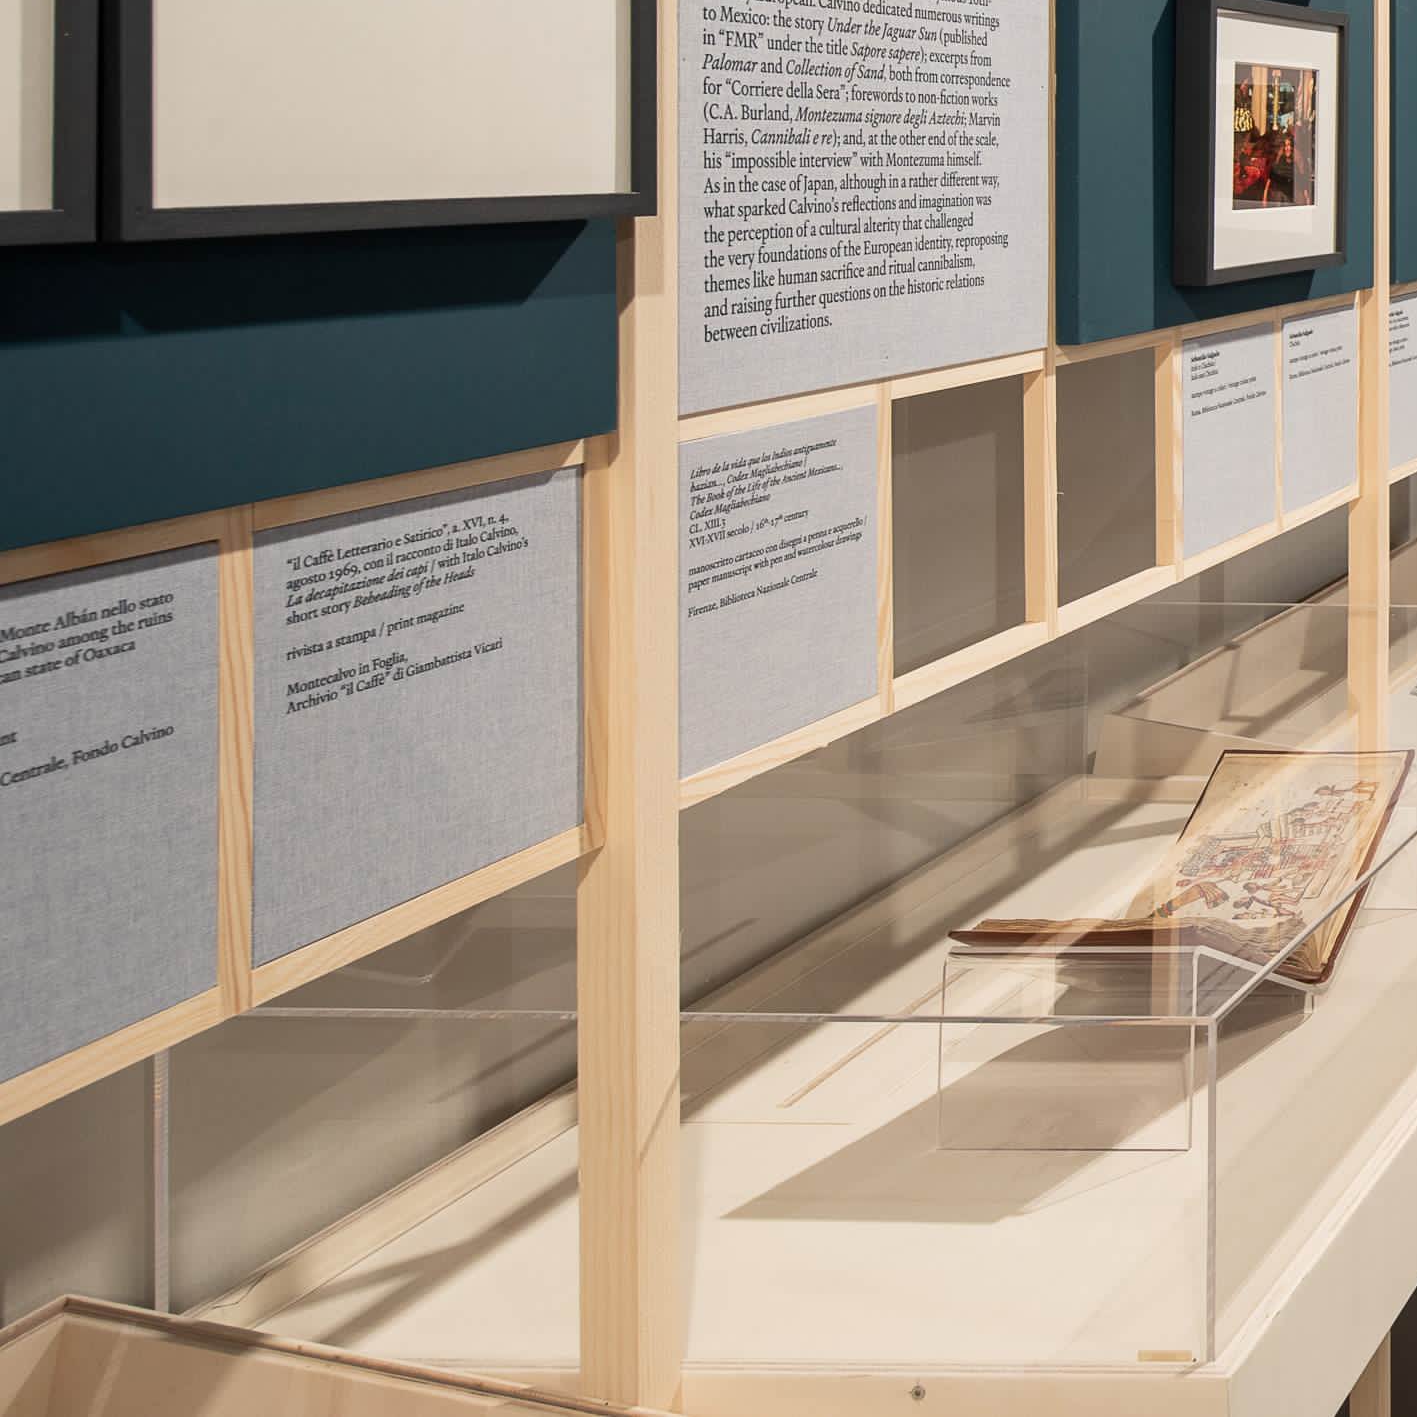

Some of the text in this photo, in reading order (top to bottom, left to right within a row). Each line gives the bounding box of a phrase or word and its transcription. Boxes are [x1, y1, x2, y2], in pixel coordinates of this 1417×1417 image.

[704, 253, 976, 293] themes like human sacrifice and ritual cannibalism,
[704, 273, 985, 318] and raising further questions on the historic relations
[704, 313, 832, 343] between civilizations.
[286, 526, 519, 592] agosto 1969, con il racconto di Italo Calvino,
[303, 549, 335, 568] Caffè
[336, 538, 394, 560] Letterario
[394, 538, 402, 547] e
[462, 515, 486, 531] XVI,
[284, 590, 303, 608] La
[305, 575, 386, 603] decapitazione
[386, 567, 405, 582] dei
[406, 561, 429, 578] capi
[437, 553, 460, 568] with
[462, 547, 485, 564] Italo
[286, 565, 476, 626] short story Beheading of the Heads
[0, 593, 174, 643] Monte Albán nello stato
[57, 628, 109, 649] among
[111, 620, 135, 636] the
[137, 612, 174, 630] ruins
[286, 604, 465, 661] rivista a stampa / print magazine
[23, 660, 63, 678] state
[64, 649, 83, 667] of
[82, 641, 136, 662] Oaxaca
[286, 652, 408, 697] Montecalvo in Foglia,
[286, 689, 338, 715] Archivio
[392, 667, 404, 681] di
[405, 650, 472, 677] Giambattista
[474, 637, 503, 655] Vicari
[0, 726, 175, 787] Centrale, Fondo Calvino
